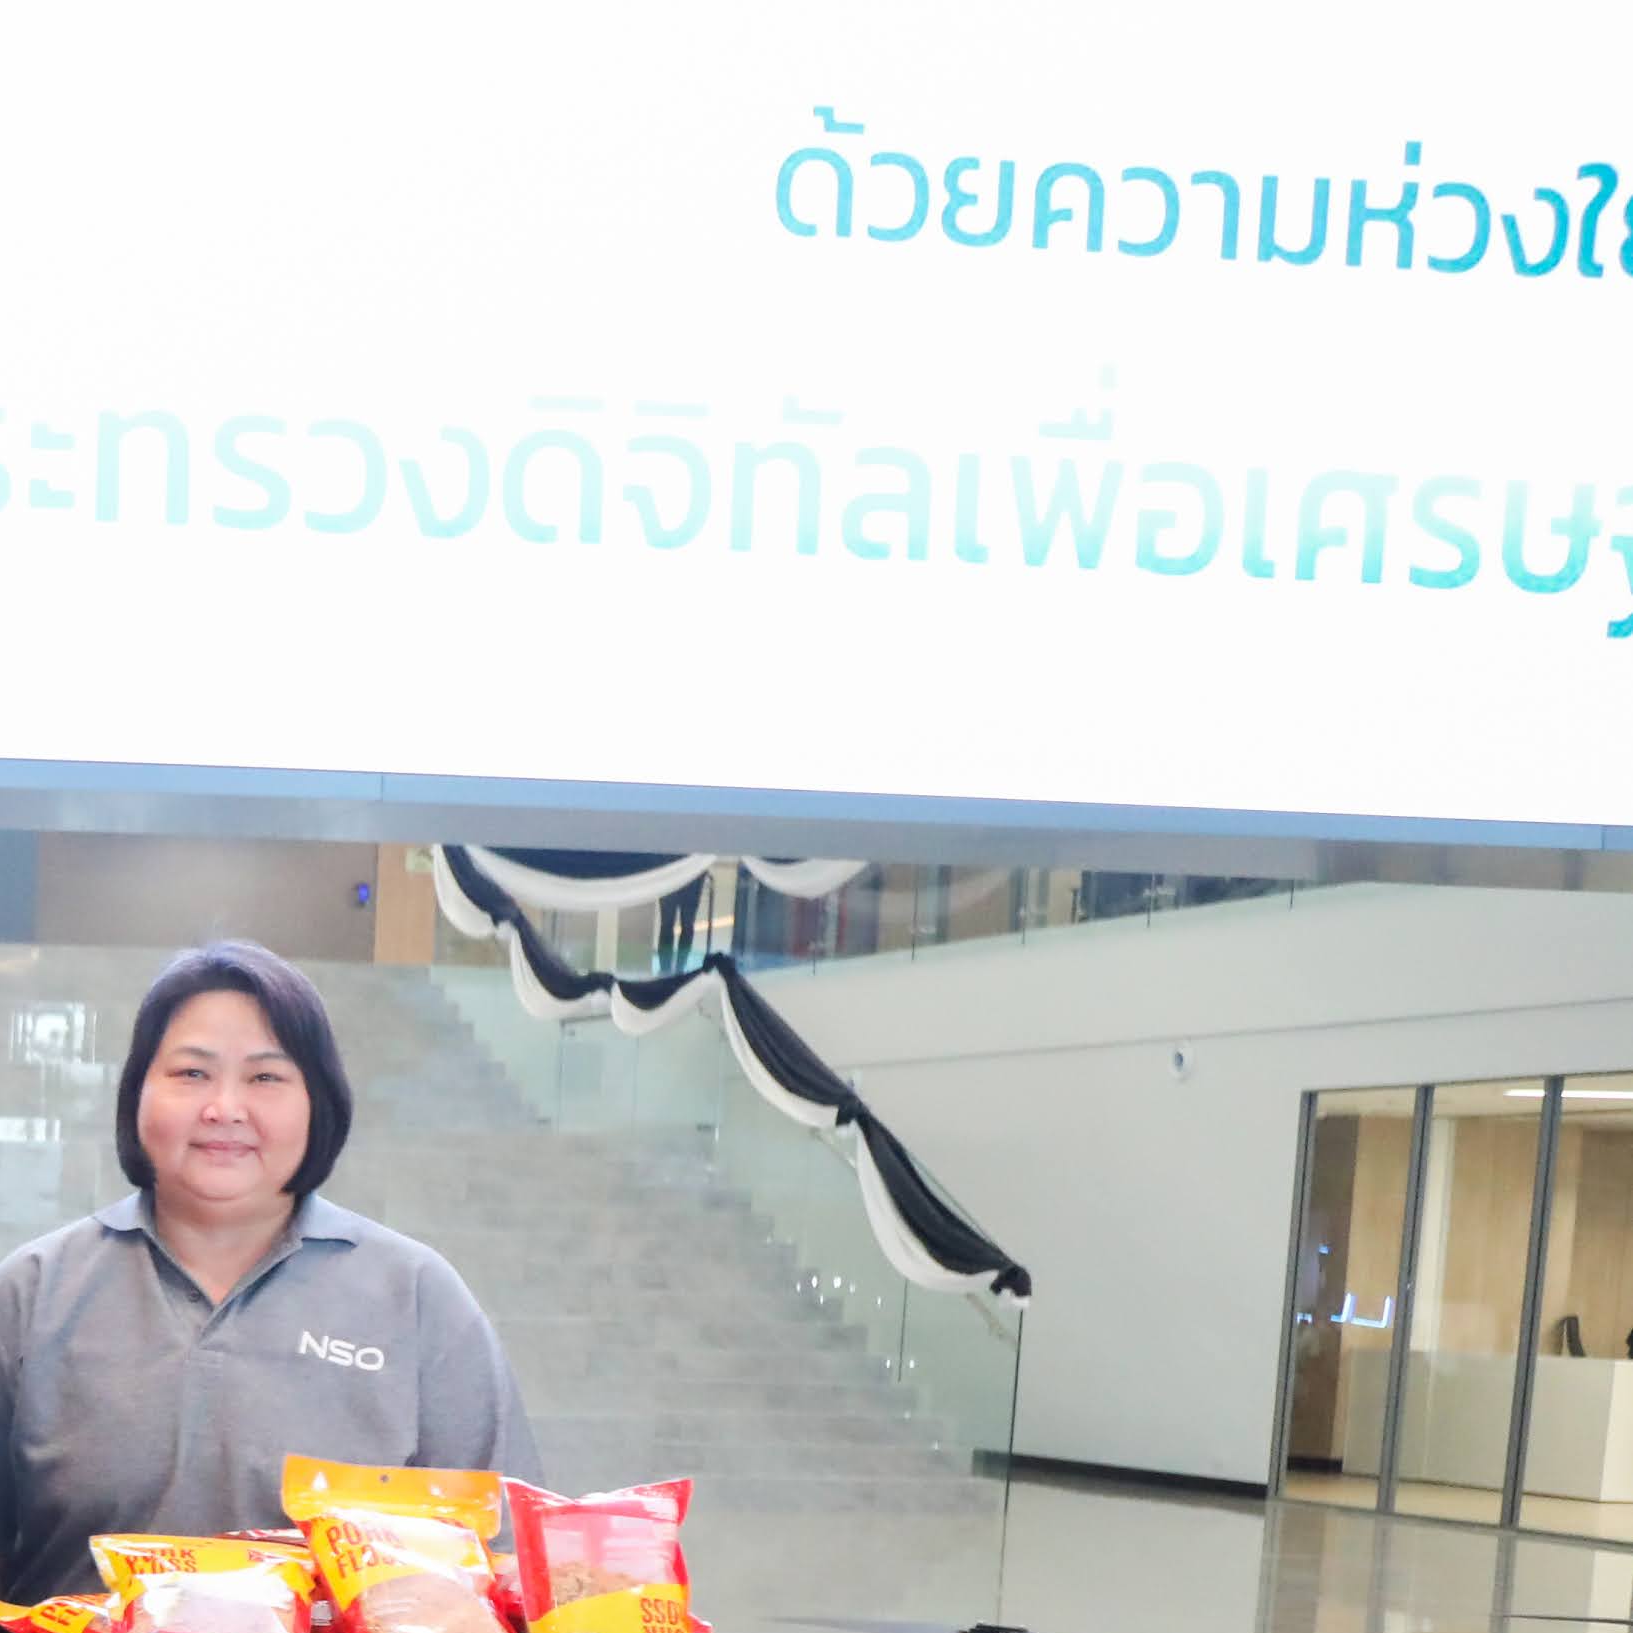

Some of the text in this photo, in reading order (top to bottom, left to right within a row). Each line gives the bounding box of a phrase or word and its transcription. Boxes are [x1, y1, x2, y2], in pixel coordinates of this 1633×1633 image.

[775, 106, 1633, 278] ด้วยความห่วงใ
[299, 1331, 385, 1371] NSO
